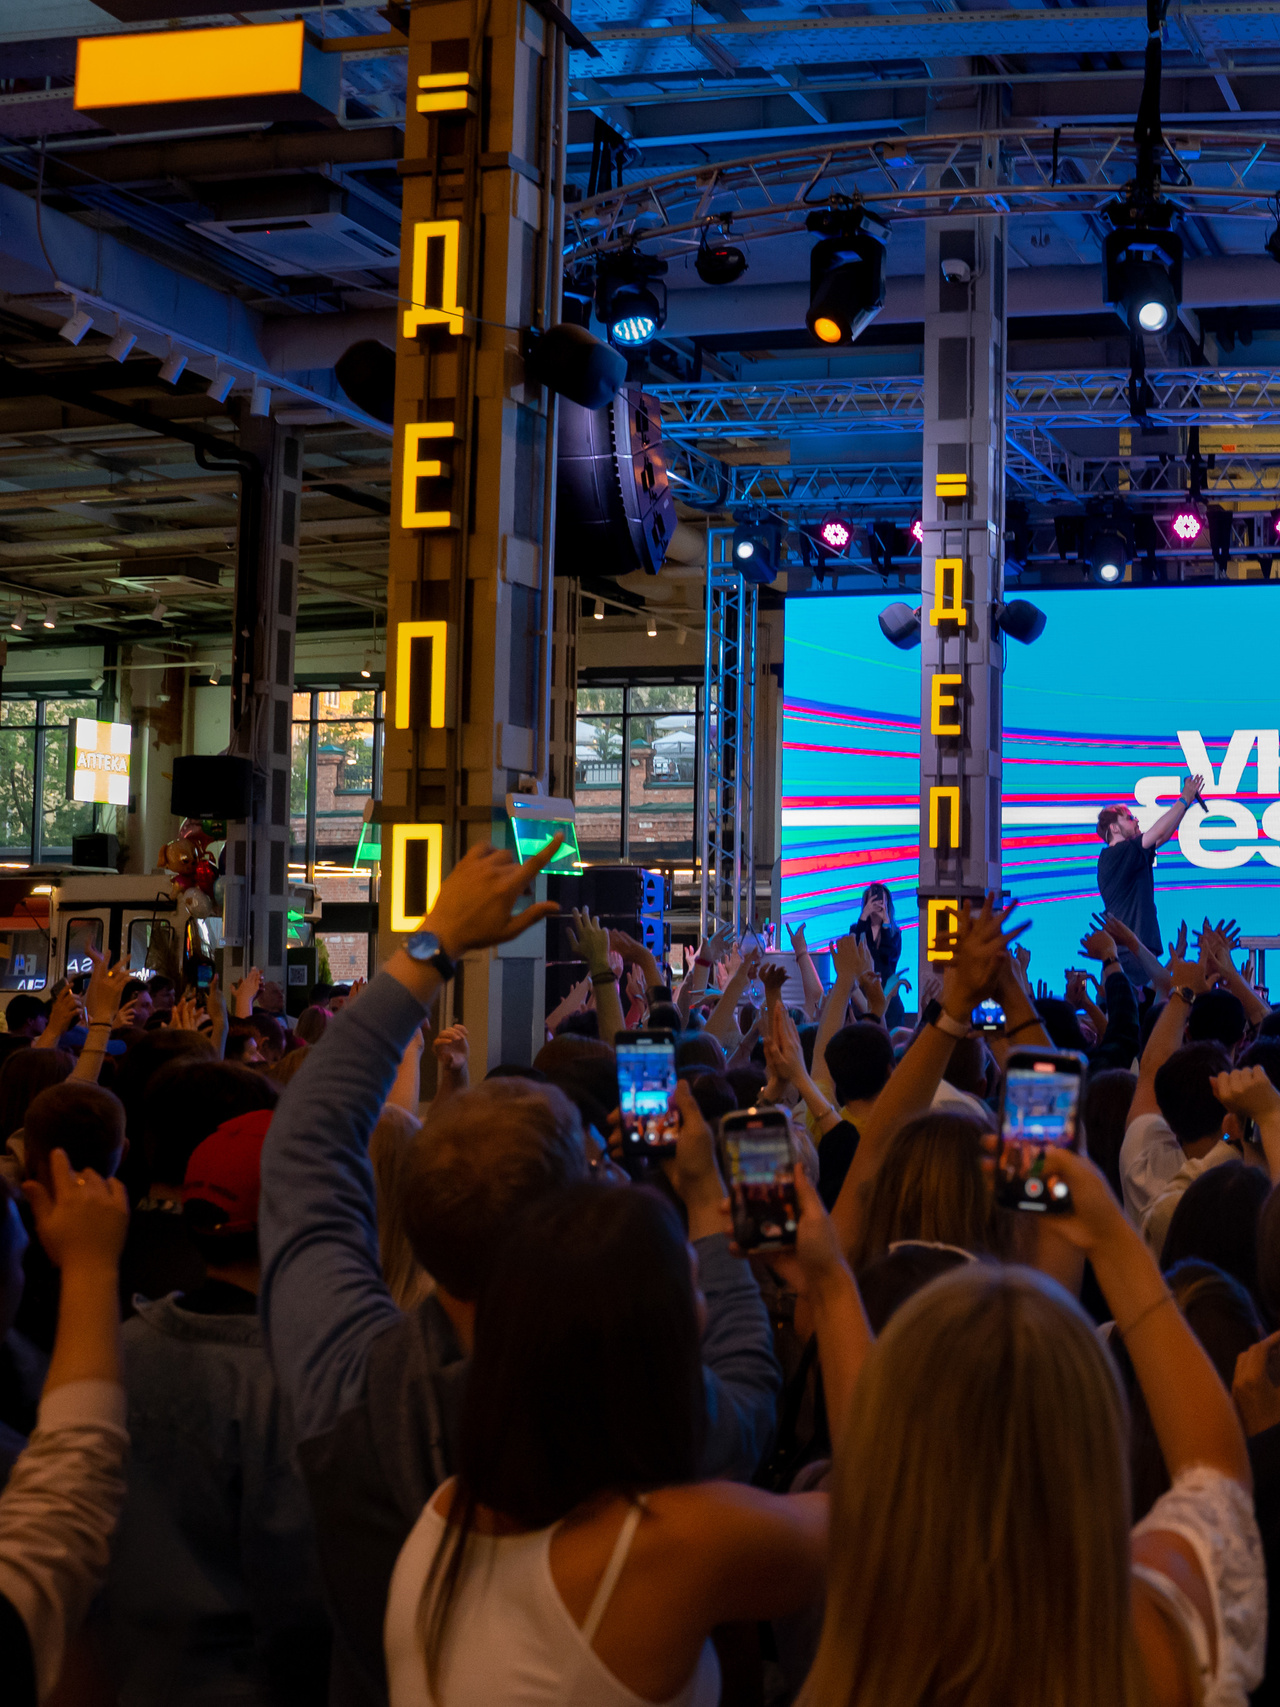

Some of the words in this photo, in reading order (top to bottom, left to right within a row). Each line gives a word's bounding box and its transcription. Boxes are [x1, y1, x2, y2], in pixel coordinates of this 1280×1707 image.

[77, 752, 128, 773] АПТЕКА
[390, 219, 468, 932] ДЕПО
[927, 558, 967, 962] ДЕПО
